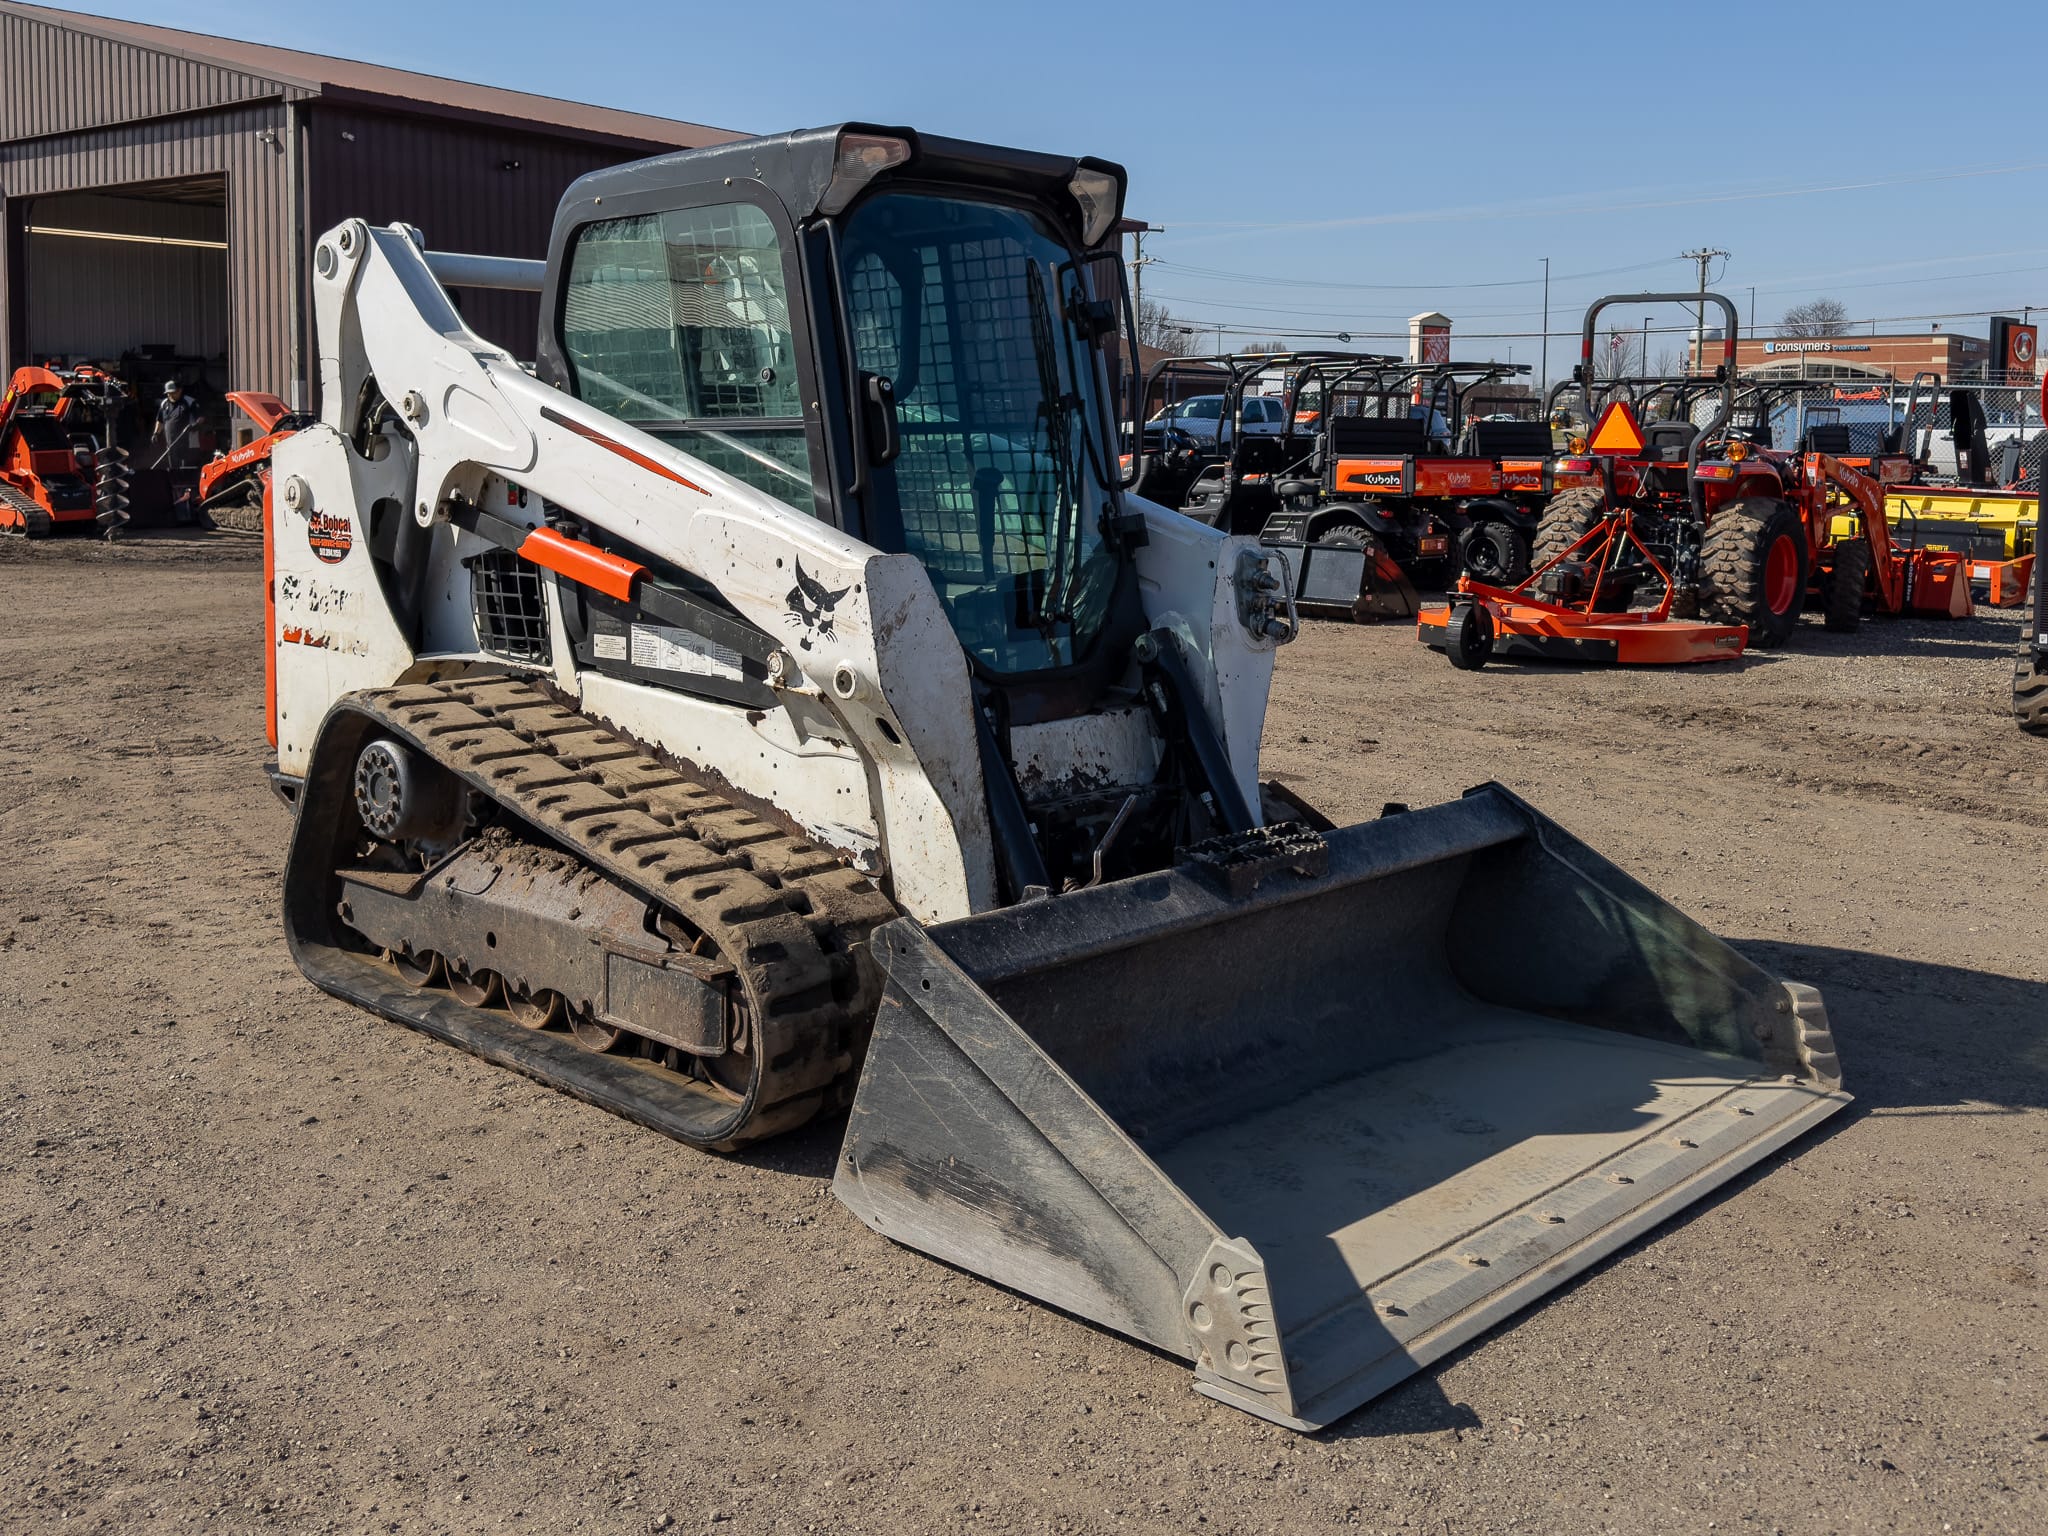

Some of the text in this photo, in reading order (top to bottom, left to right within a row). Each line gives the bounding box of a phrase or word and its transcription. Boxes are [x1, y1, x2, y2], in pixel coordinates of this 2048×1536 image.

[1775, 342, 1830, 352] consumers
[1365, 474, 1400, 485] Kubota
[1448, 472, 1470, 484] Kubota
[323, 514, 351, 532] Bobcat
